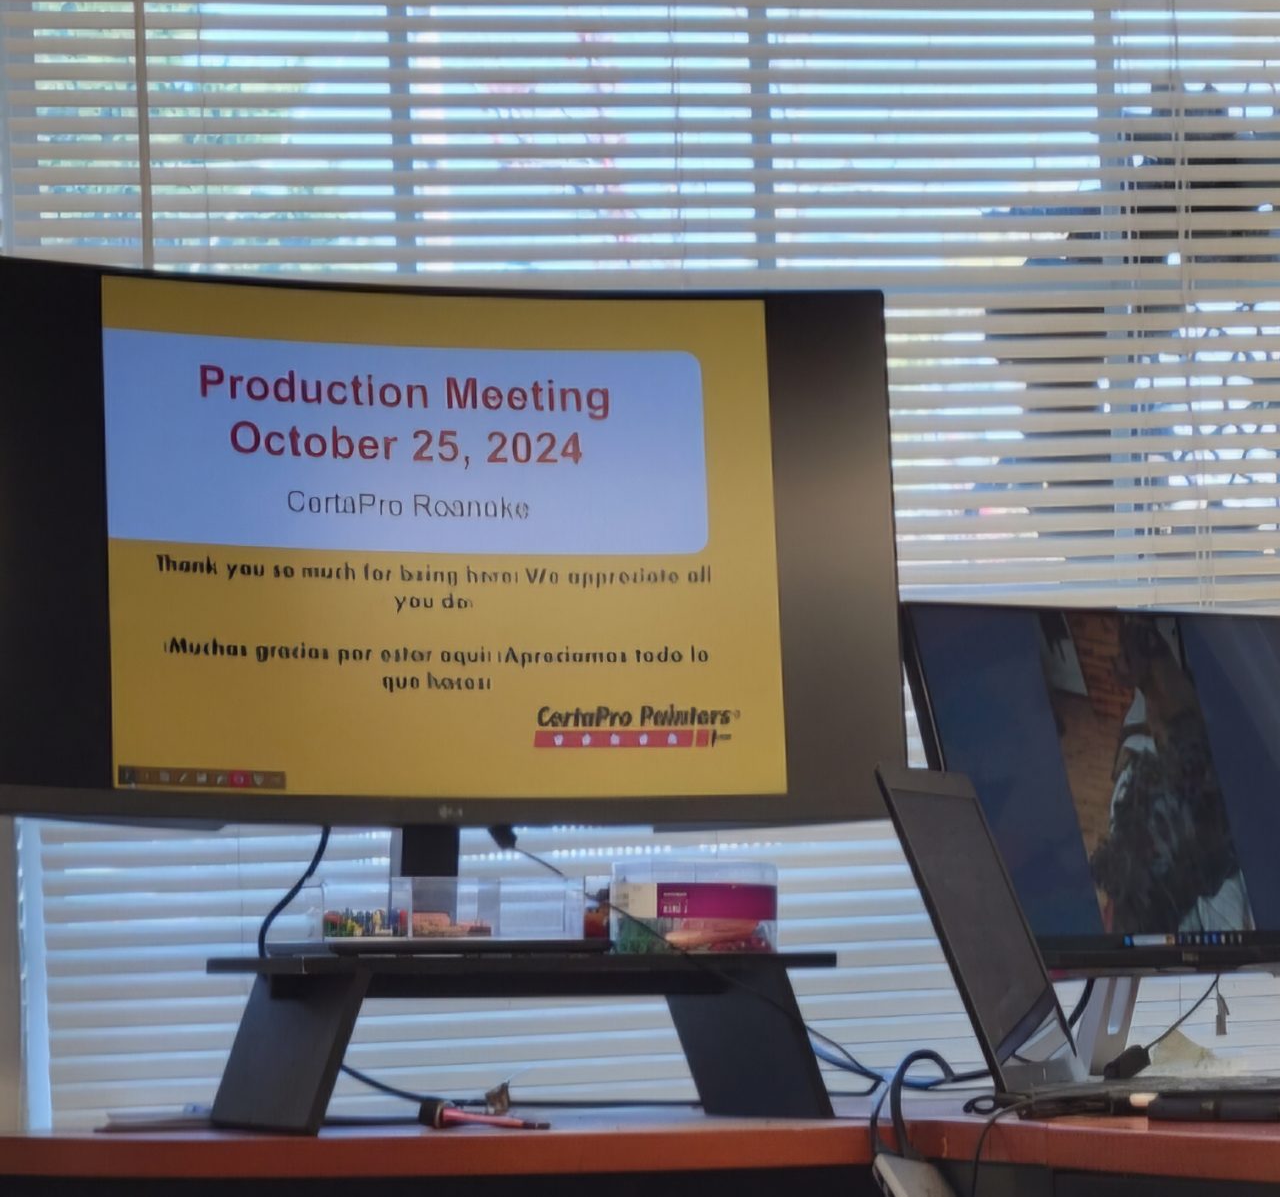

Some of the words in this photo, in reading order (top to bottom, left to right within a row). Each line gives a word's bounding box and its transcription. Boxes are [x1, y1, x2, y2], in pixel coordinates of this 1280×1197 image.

[199, 364, 429, 409] Production
[446, 376, 610, 421] Meeting
[229, 420, 398, 461] October
[412, 429, 470, 471] 25,
[486, 430, 583, 466] 2024
[287, 490, 403, 517] CertaPro
[413, 494, 530, 520] Roanoke
[156, 554, 218, 575] Thank
[226, 562, 265, 580] you
[273, 564, 295, 579] so
[301, 562, 356, 581] much
[363, 563, 392, 582] for
[400, 564, 458, 586] being
[525, 567, 559, 585] We
[568, 568, 680, 590] appreciate
[687, 565, 712, 585] all
[394, 595, 434, 615] you
[255, 642, 330, 662] gracias
[338, 648, 373, 666] por
[380, 646, 433, 663] estar
[635, 645, 684, 664] todo
[690, 644, 710, 664] lo
[382, 675, 420, 693] que
[536, 705, 634, 729] CertaPro
